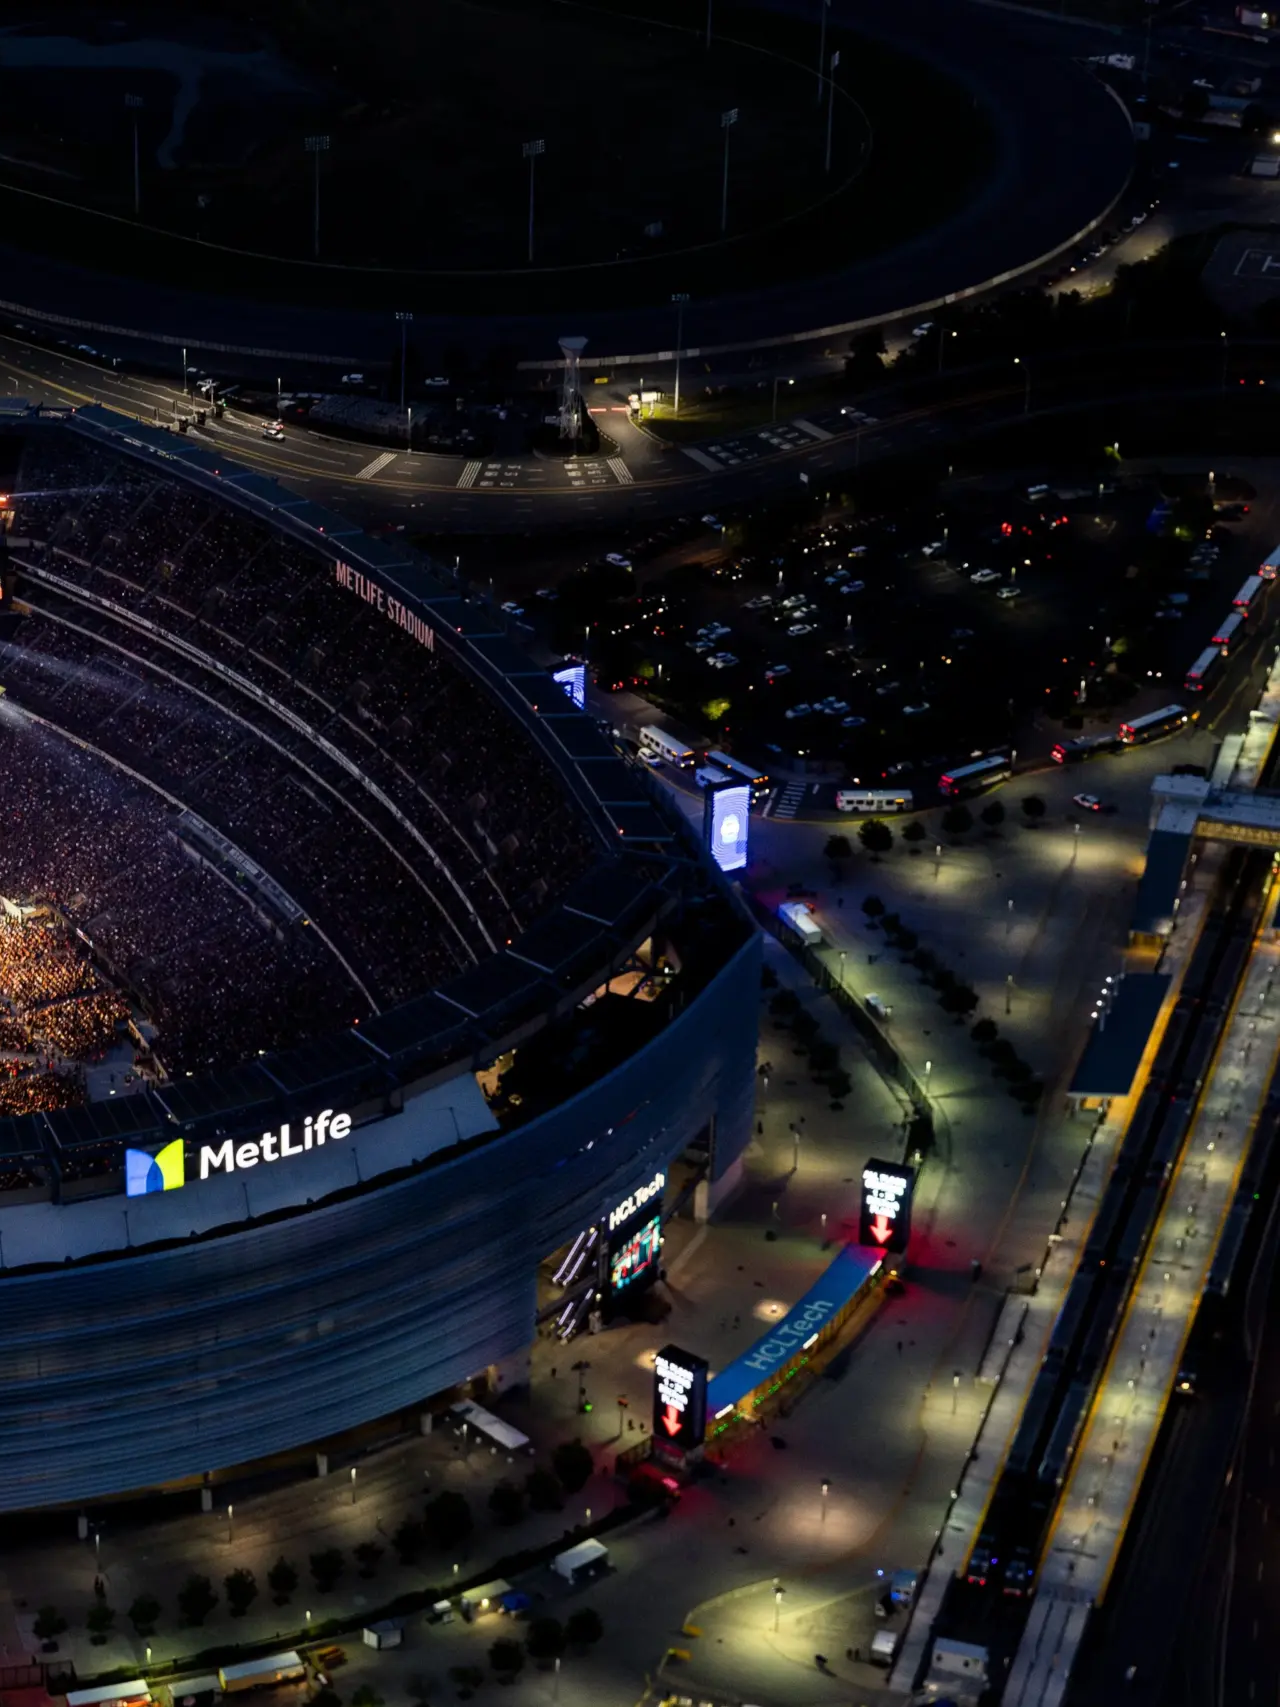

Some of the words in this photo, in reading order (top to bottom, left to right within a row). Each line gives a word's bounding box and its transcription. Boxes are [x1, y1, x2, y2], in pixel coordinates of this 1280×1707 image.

[336, 560, 385, 612] METLIFE
[387, 596, 434, 653] STADIUM
[199, 1108, 352, 1180] MetLife
[609, 1172, 665, 1231] HCLTech
[743, 1300, 834, 1371] HCLTech
